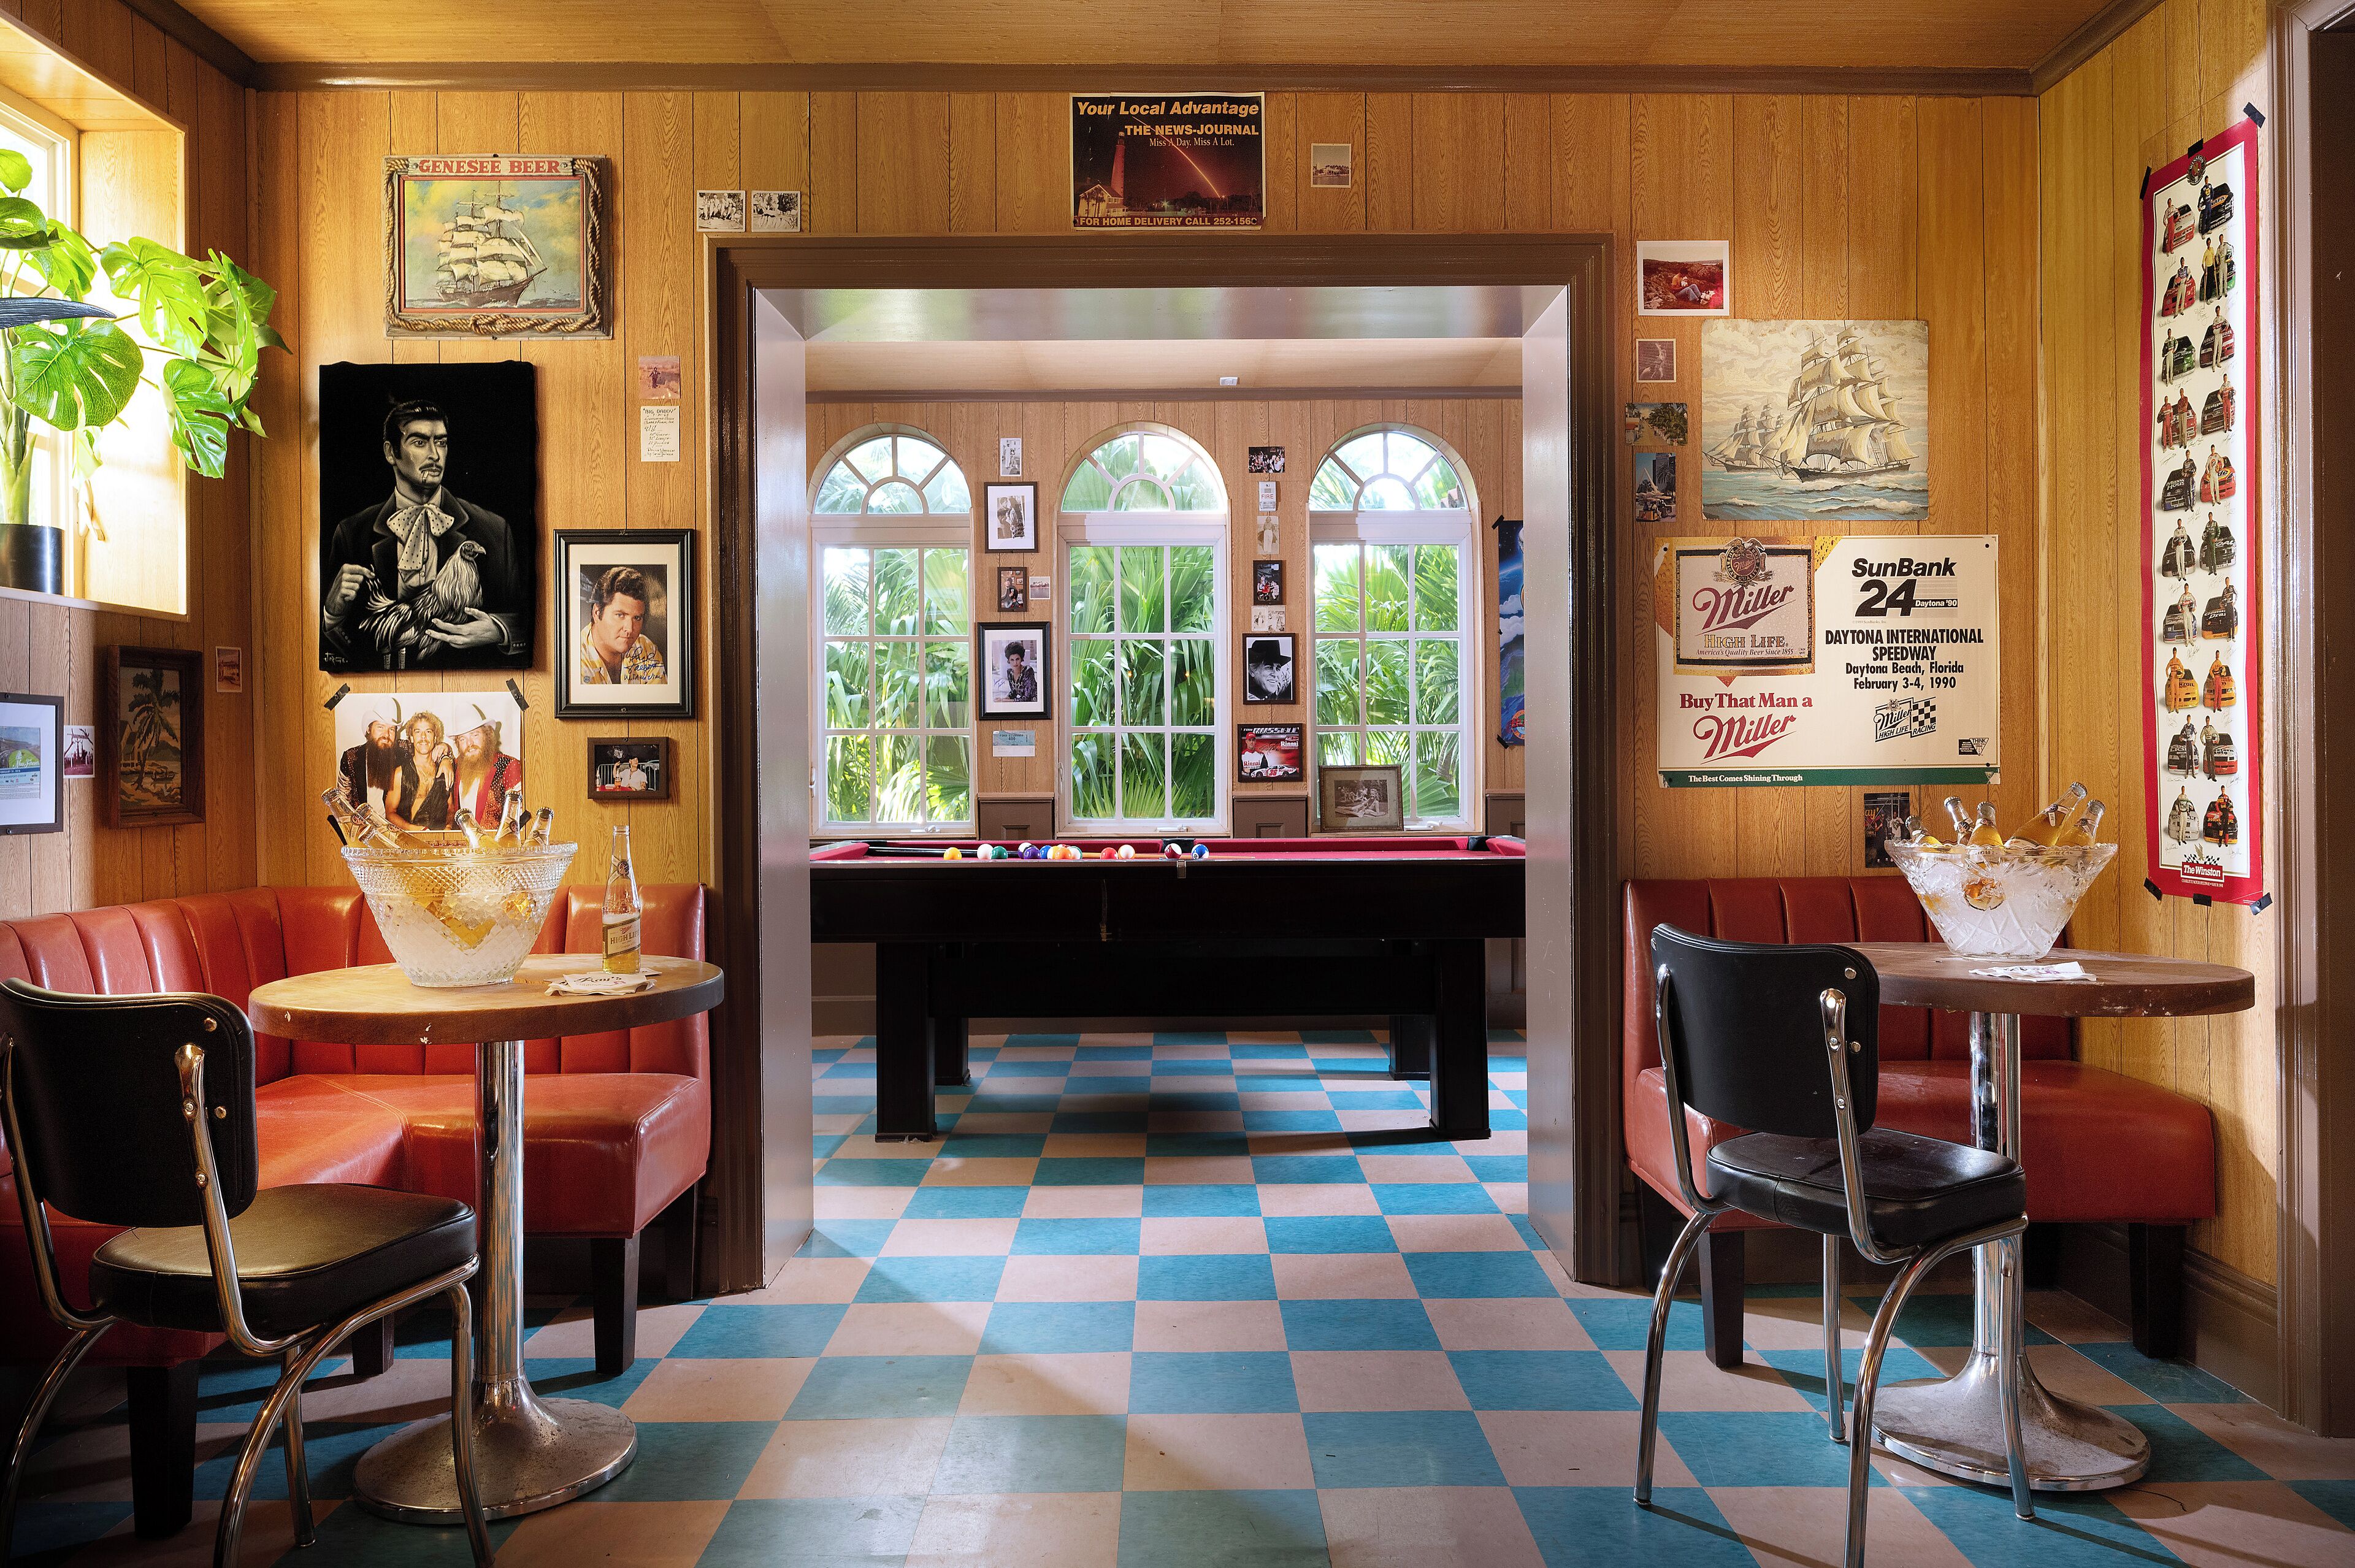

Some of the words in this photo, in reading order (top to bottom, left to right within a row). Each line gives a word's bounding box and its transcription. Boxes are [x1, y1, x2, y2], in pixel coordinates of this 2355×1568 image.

[1078, 102, 1115, 115] Your
[1119, 101, 1166, 115] Local
[1170, 101, 1259, 117] Advantage
[1125, 125, 1151, 136] THE
[1155, 124, 1259, 136] NEWS-JOURNAL
[1149, 138, 1166, 147] Miss
[1168, 138, 1175, 147] A
[1176, 137, 1192, 148] Day.
[1193, 137, 1211, 146] Miss
[1212, 137, 1219, 146] A
[1220, 137, 1235, 146] Lot.
[418, 159, 501, 174] GENESEE
[509, 159, 560, 174] BEER
[1079, 217, 1100, 226] FOR
[1102, 217, 1132, 226] HOME
[1134, 217, 1183, 226] DELIVERY
[1185, 217, 1211, 226] CALL
[1851, 557, 1958, 577] SunBank
[1855, 578, 1917, 617] 24
[1915, 600, 1945, 608] Daytona
[1693, 584, 1795, 635] Miller
[1704, 634, 1746, 648] HIGH
[1825, 629, 1883, 644] DAYTONA
[1886, 628, 1984, 644] INTERNATIONAL
[1872, 646, 1937, 662] SPEEDWAY
[1845, 662, 1888, 677] Daytona
[1891, 660, 1925, 676] Beach,
[1929, 660, 1964, 674] Florida
[1853, 678, 1898, 692] February
[1902, 677, 1924, 690] 3-4,
[1930, 676, 1956, 689] 1990
[1679, 693, 1716, 711] Buy
[1717, 693, 1756, 708] That
[1758, 692, 1798, 708] Man
[1801, 695, 1813, 708] a
[1873, 706, 1912, 730] Miller
[1693, 713, 1797, 763] Miller
[1878, 727, 1895, 740] HIGH
[1895, 724, 1909, 737] LIFE
[1912, 722, 1937, 735] RACING
[1702, 774, 1718, 783] Best
[1719, 774, 1743, 783] Comes
[1744, 774, 1772, 784] Shining
[1772, 773, 1803, 784] Through
[2183, 865, 2195, 874] The
[2195, 866, 2221, 877] Winston
[610, 935, 629, 944] HIGH
